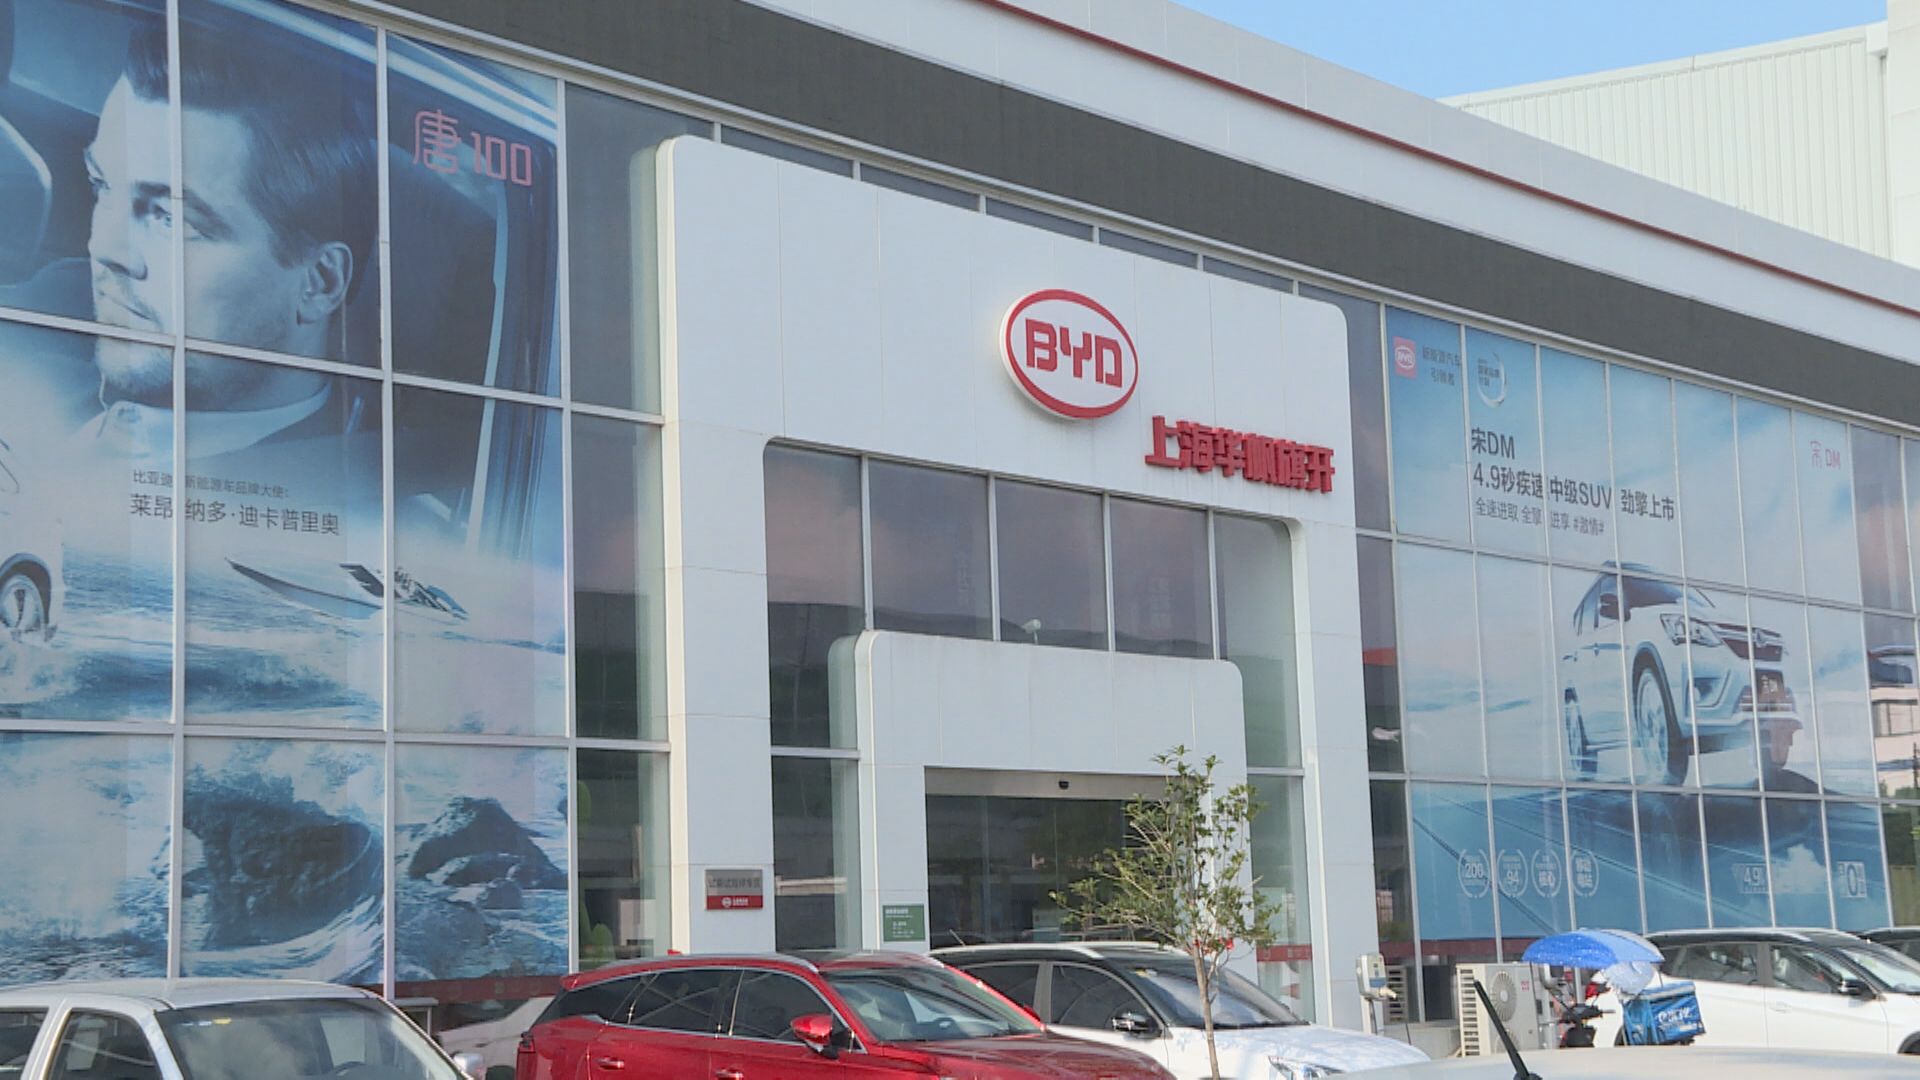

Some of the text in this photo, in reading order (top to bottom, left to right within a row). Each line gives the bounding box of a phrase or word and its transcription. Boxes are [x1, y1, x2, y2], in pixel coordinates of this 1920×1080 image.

[413, 109, 531, 186] 唐 100
[1025, 318, 1122, 388] BYD
[1472, 427, 1515, 460] 宋DM
